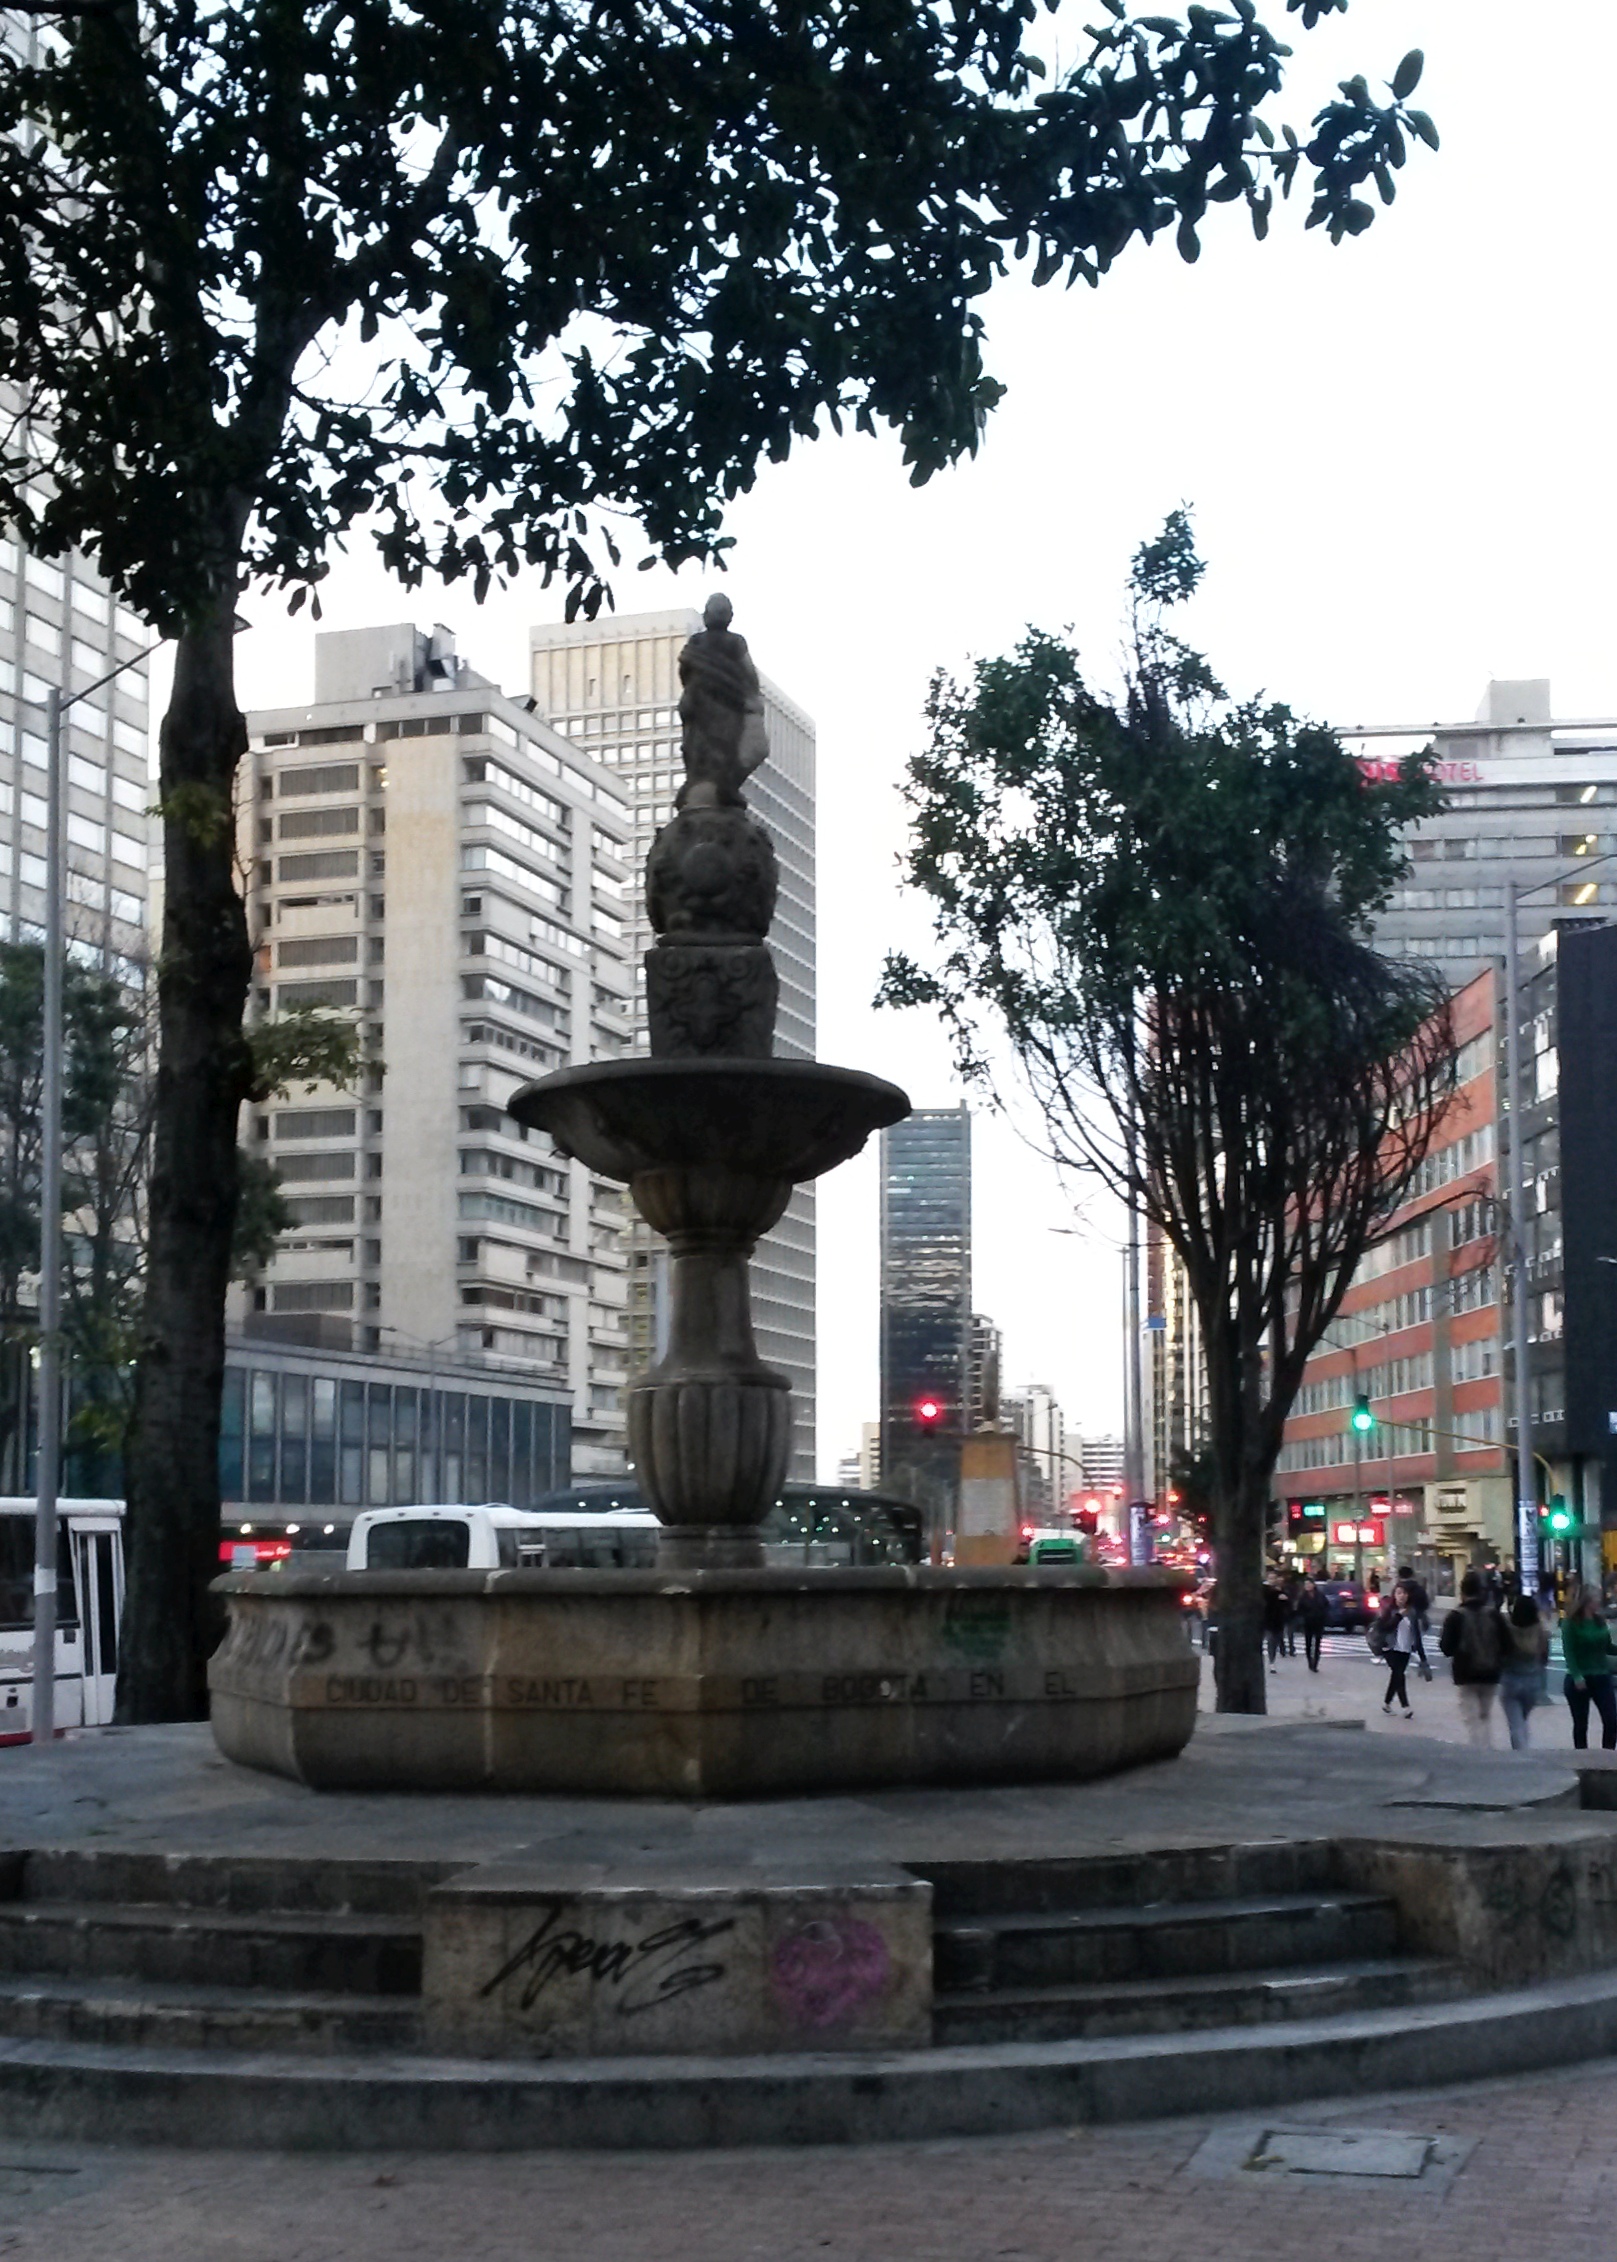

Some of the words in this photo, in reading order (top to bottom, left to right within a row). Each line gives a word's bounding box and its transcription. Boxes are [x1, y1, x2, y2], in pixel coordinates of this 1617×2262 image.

[1415, 761, 1483, 783] OTEL
[327, 1677, 417, 1702] CIUDAD
[443, 1677, 481, 1702] DE
[508, 1679, 594, 1704] SANTA
[622, 1679, 658, 1705] FE
[741, 1678, 778, 1701] DE
[971, 1671, 1004, 1696] EN
[1045, 1671, 1076, 1694] EL
